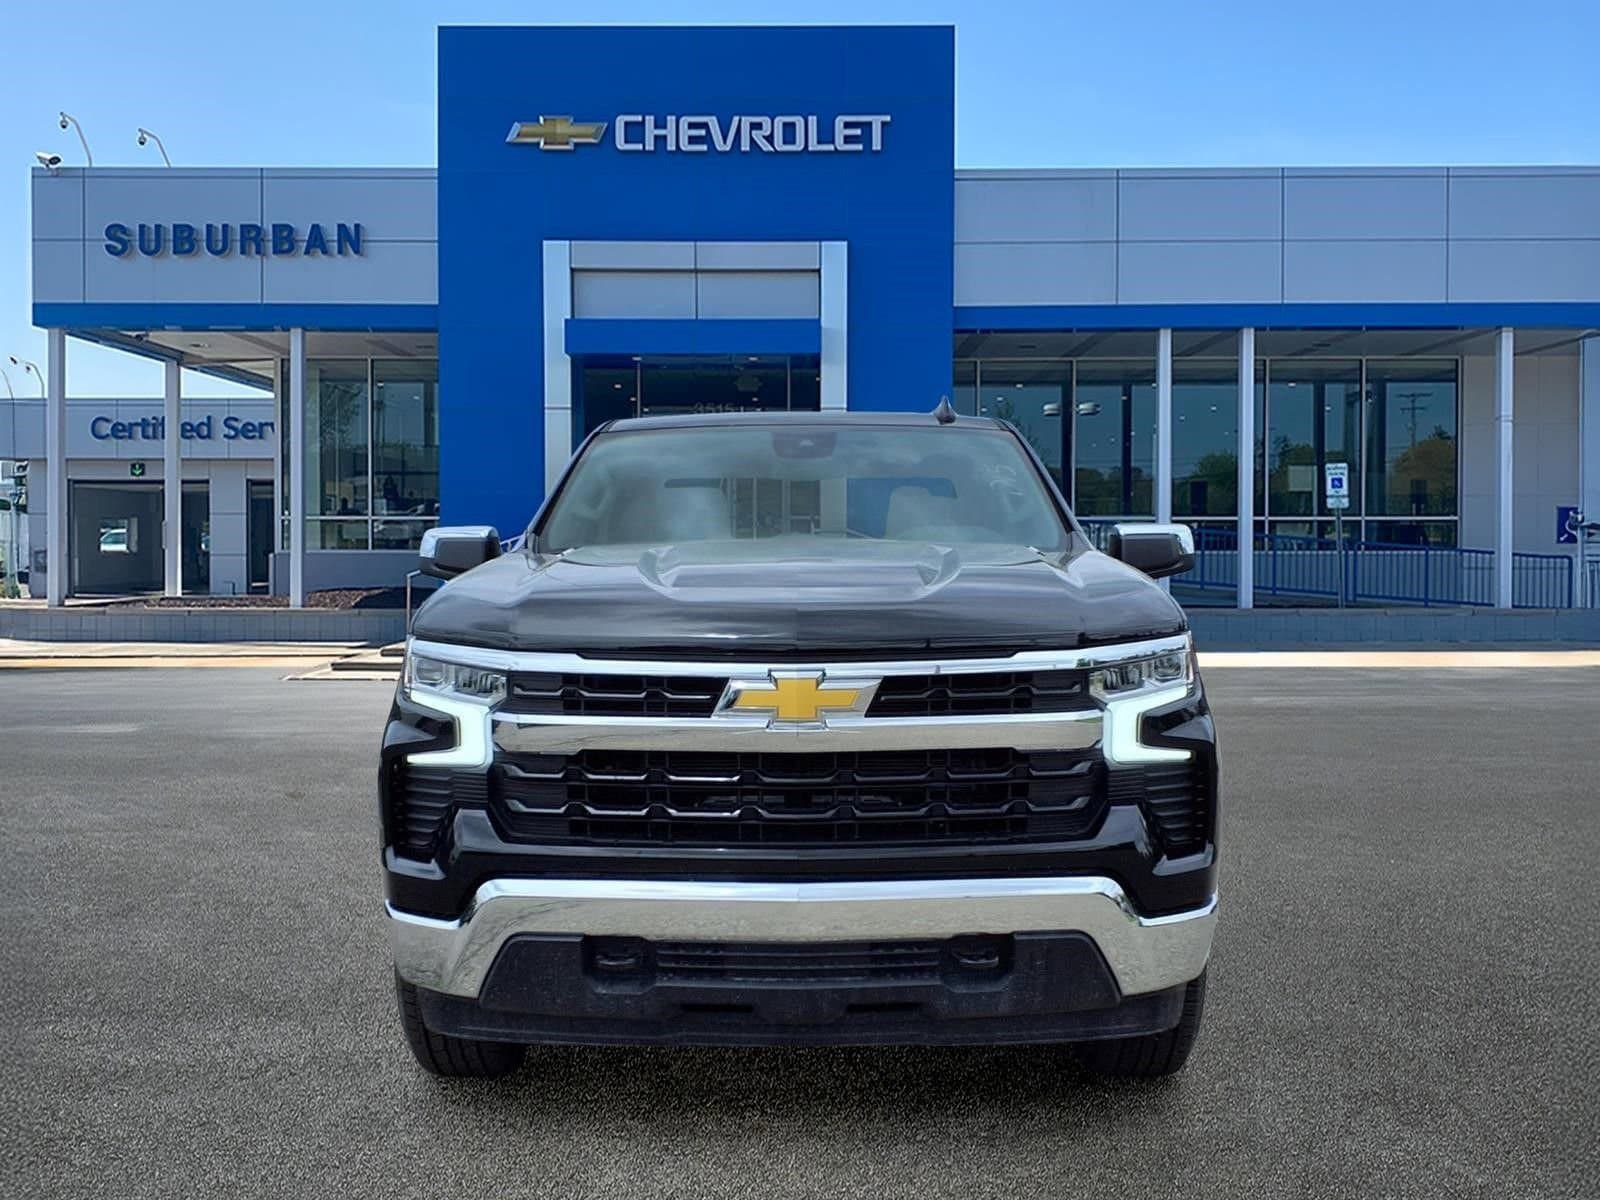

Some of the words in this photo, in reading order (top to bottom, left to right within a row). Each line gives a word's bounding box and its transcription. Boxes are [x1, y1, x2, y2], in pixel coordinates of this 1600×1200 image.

[614, 114, 892, 153] CHEVROLET
[104, 222, 363, 257] SUBURBAN
[91, 415, 212, 441] Certifed
